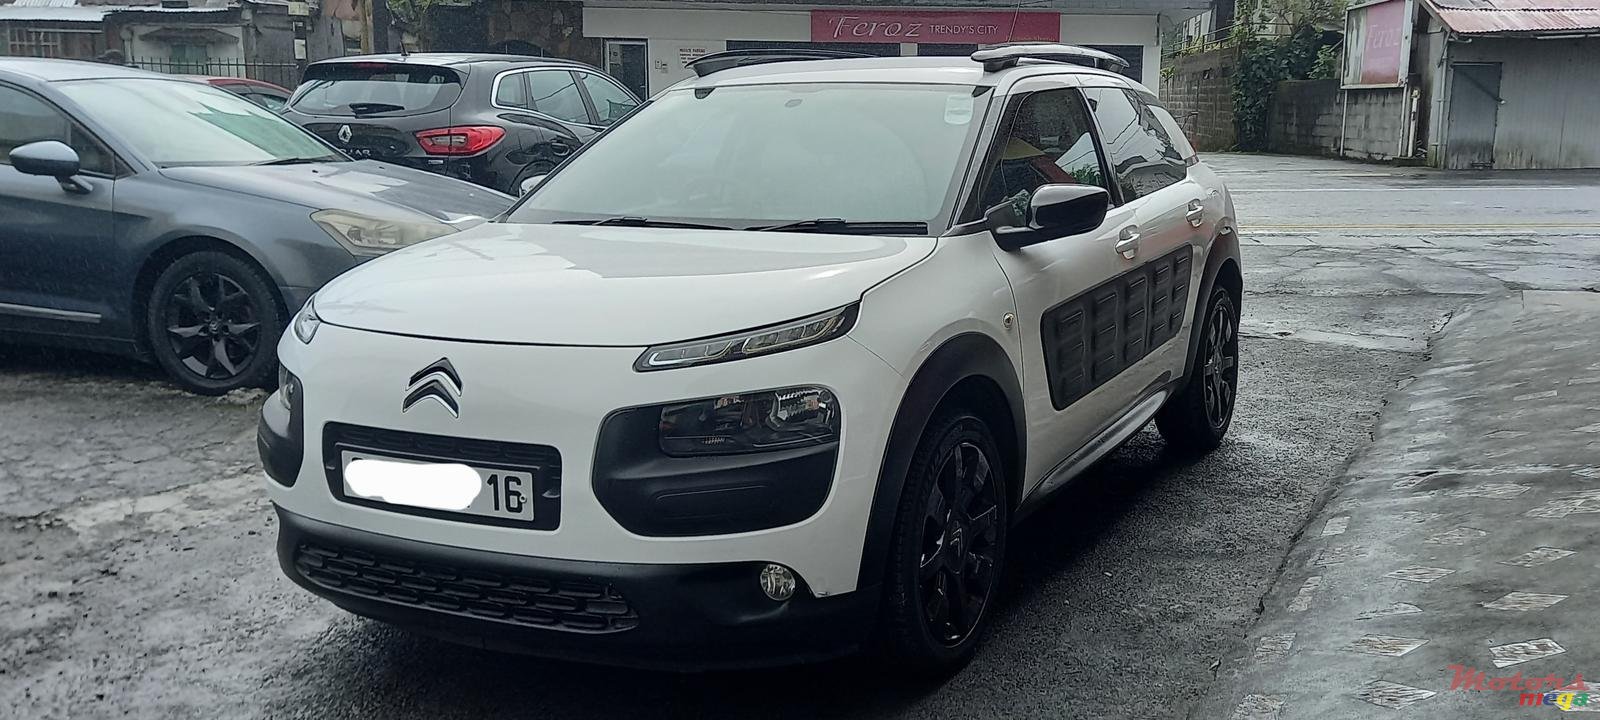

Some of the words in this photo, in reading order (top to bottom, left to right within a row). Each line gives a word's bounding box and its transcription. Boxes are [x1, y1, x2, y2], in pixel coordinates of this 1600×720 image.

[829, 16, 922, 38] Feroz
[929, 25, 974, 35] TRENDY'S
[976, 25, 999, 34] CITY
[487, 474, 523, 513] 16
